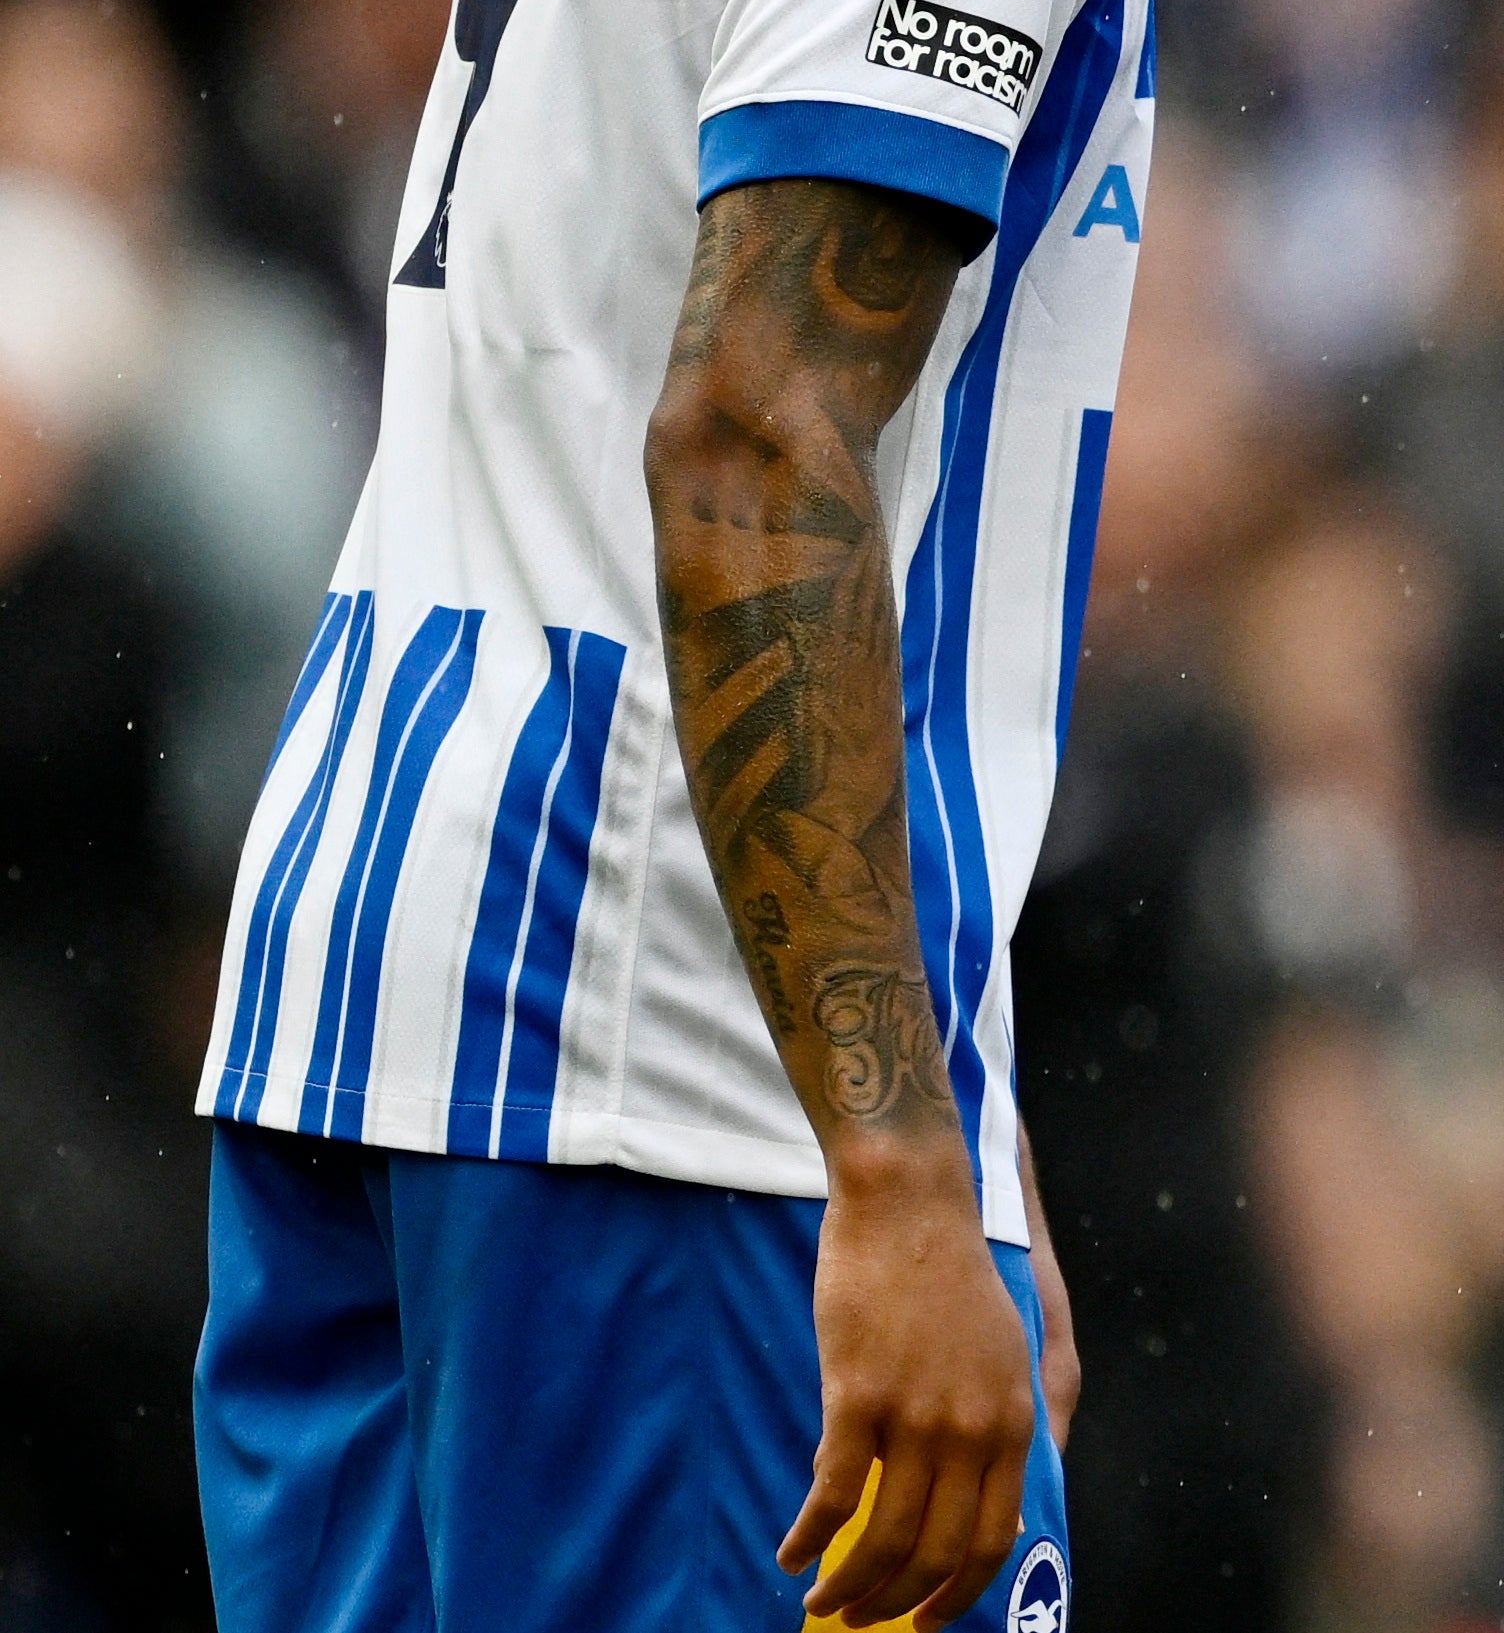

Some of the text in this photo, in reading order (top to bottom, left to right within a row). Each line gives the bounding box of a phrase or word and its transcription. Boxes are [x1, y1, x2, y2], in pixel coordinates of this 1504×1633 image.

[867, 27, 1028, 112] for racism
[944, 18, 1034, 80] room
